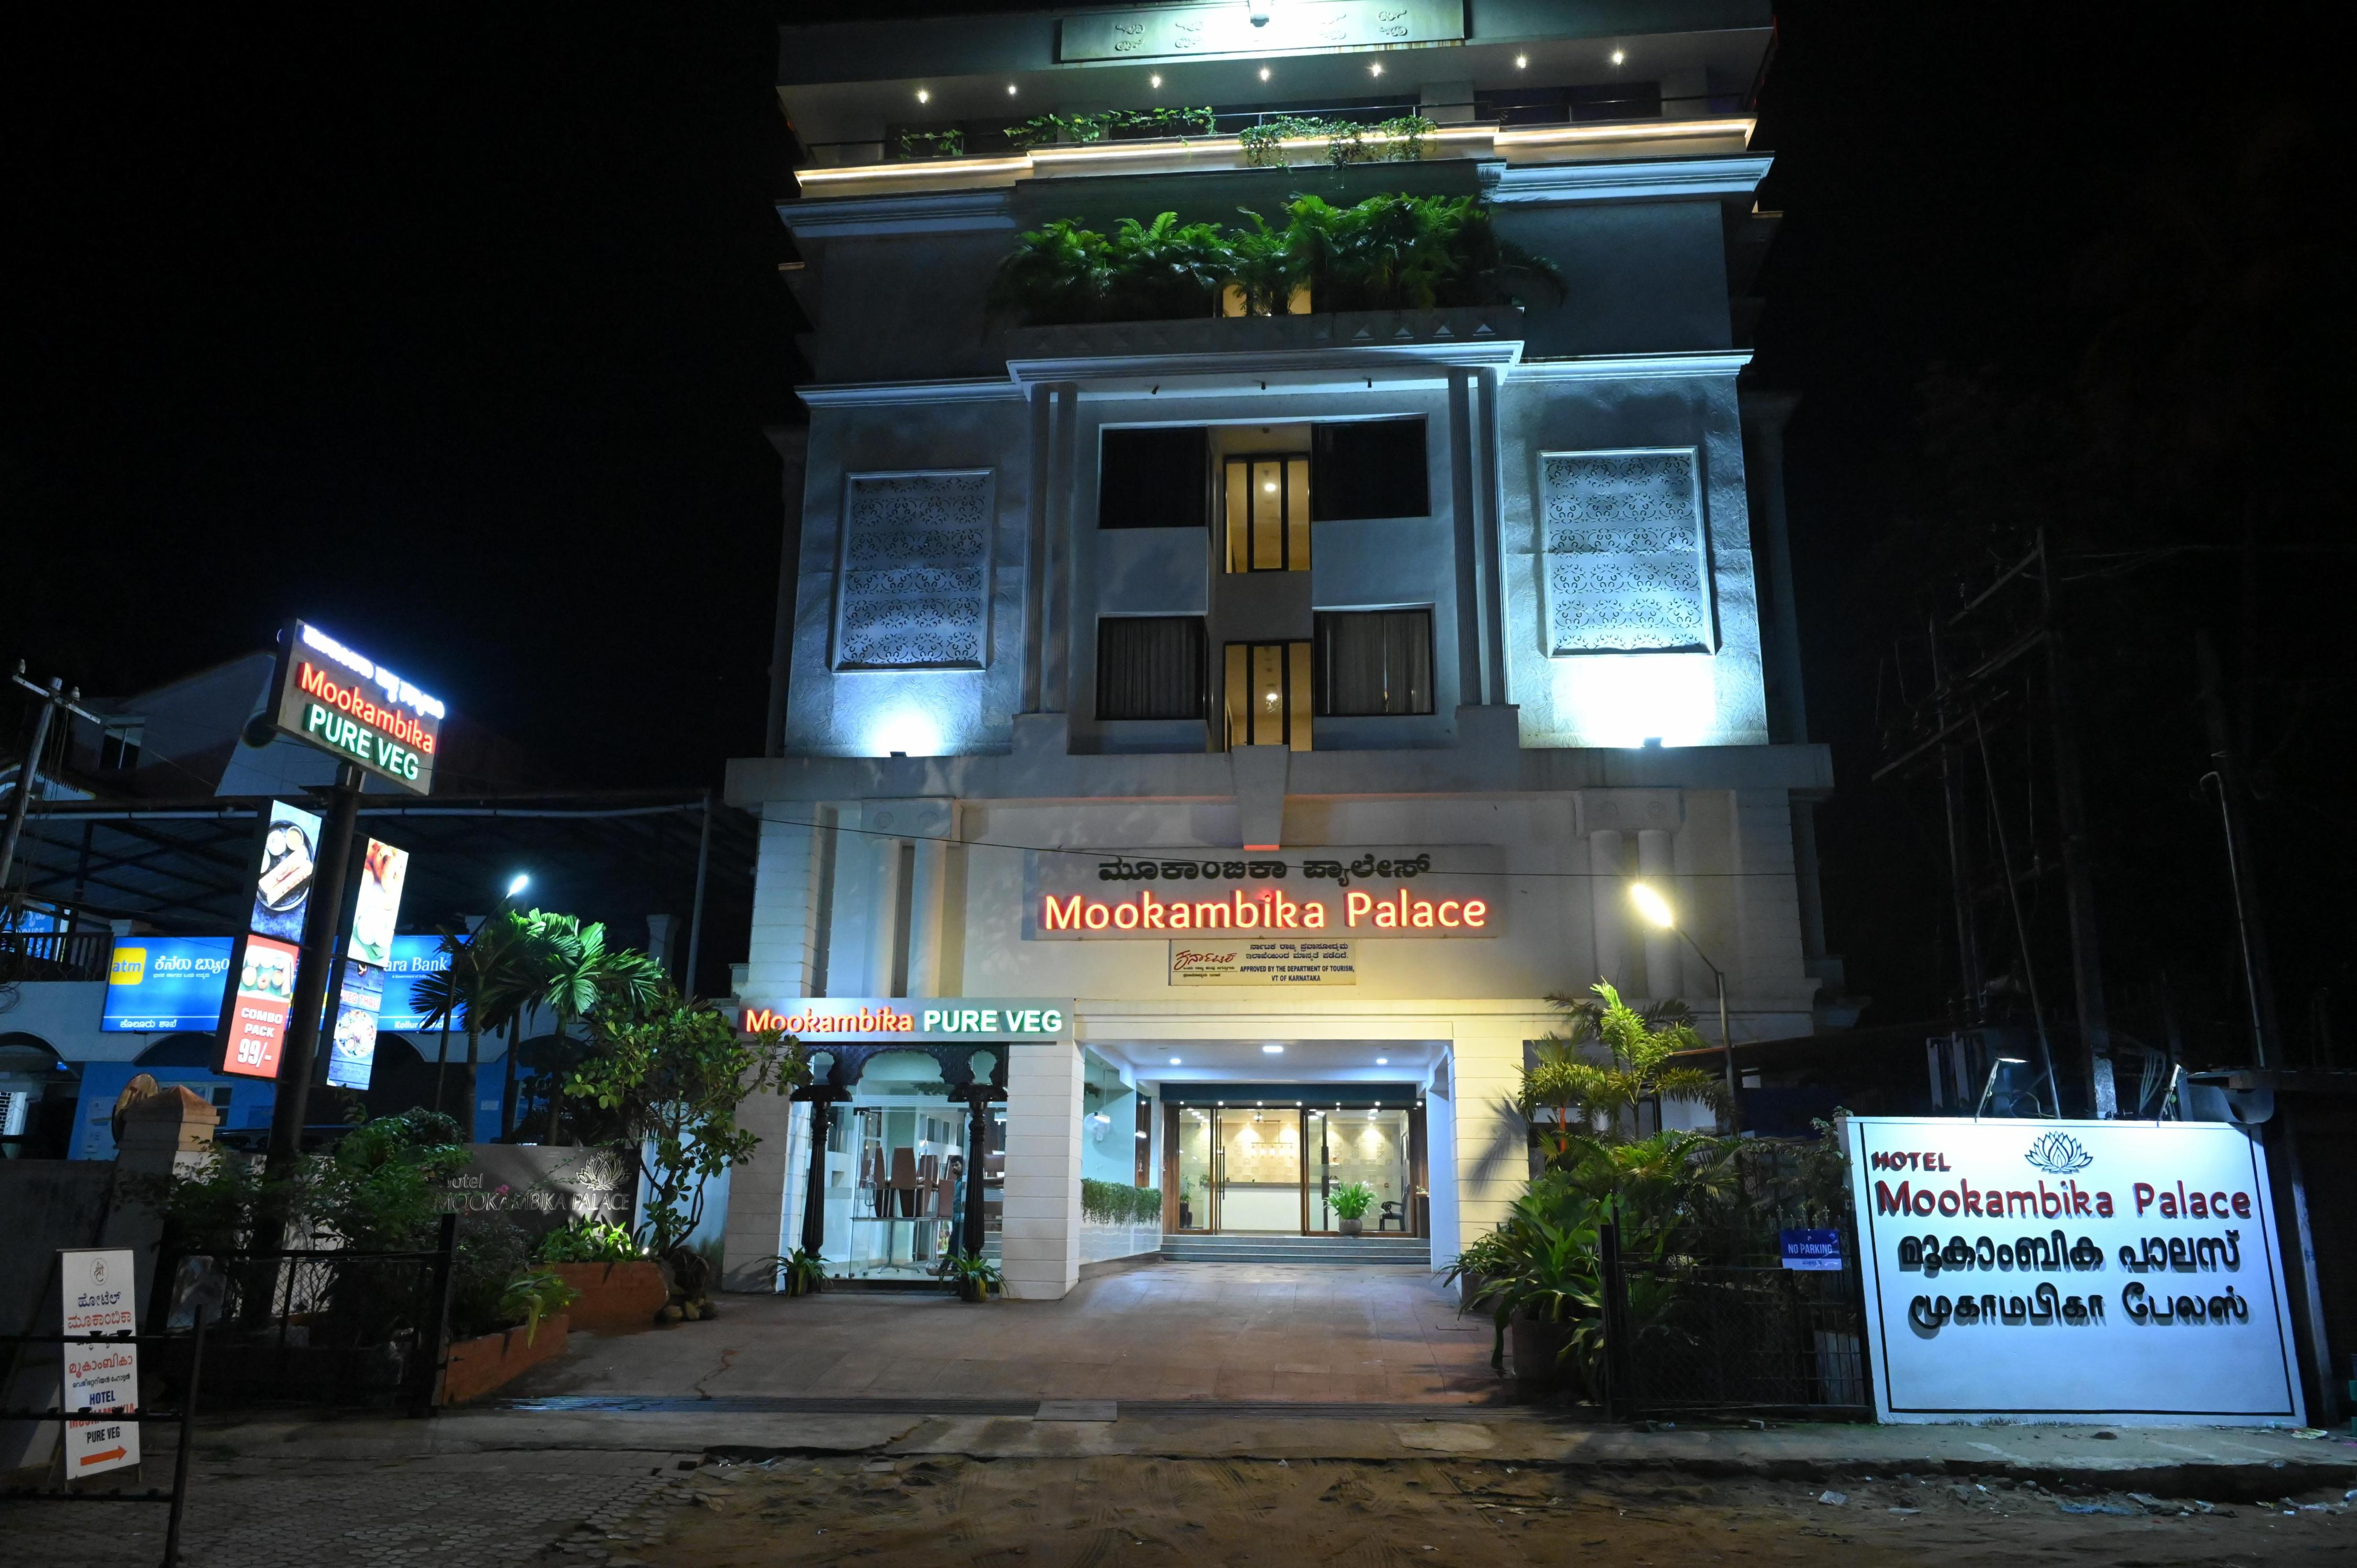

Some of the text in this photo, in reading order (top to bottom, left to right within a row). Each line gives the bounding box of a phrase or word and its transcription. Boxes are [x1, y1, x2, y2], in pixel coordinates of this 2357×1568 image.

[300, 662, 434, 754] Mookambika
[306, 704, 418, 780] PURE VEG
[1098, 853, 1430, 887] ಮೂಕಾಂಬಿಕಾ ಪ್ಯಾಲೇಸ್
[1043, 889, 1486, 930] Mookambika Palace
[113, 960, 141, 972] atm
[411, 957, 447, 972] Bank
[241, 1008, 283, 1024] COMBO
[745, 1007, 1062, 1033] Mookambika PURE VEG
[245, 1023, 276, 1038] PACK
[237, 1039, 272, 1068] 99/-
[1871, 1151, 1952, 1172] HOTEL
[438, 1173, 483, 1189] otel
[571, 1193, 630, 1211] PALACE
[1874, 1178, 2251, 1218] Mookambika Palace
[1788, 1243, 1833, 1254] NO PARKING
[1899, 1229, 2240, 1271] മൂകാംബിക പാലസ്
[78, 1291, 121, 1307] ಹೋಟೆಲ್
[2122, 1281, 2249, 1319] பேலஸ்
[90, 1390, 116, 1405] HOTEL
[87, 1426, 120, 1444] PURE VEG
